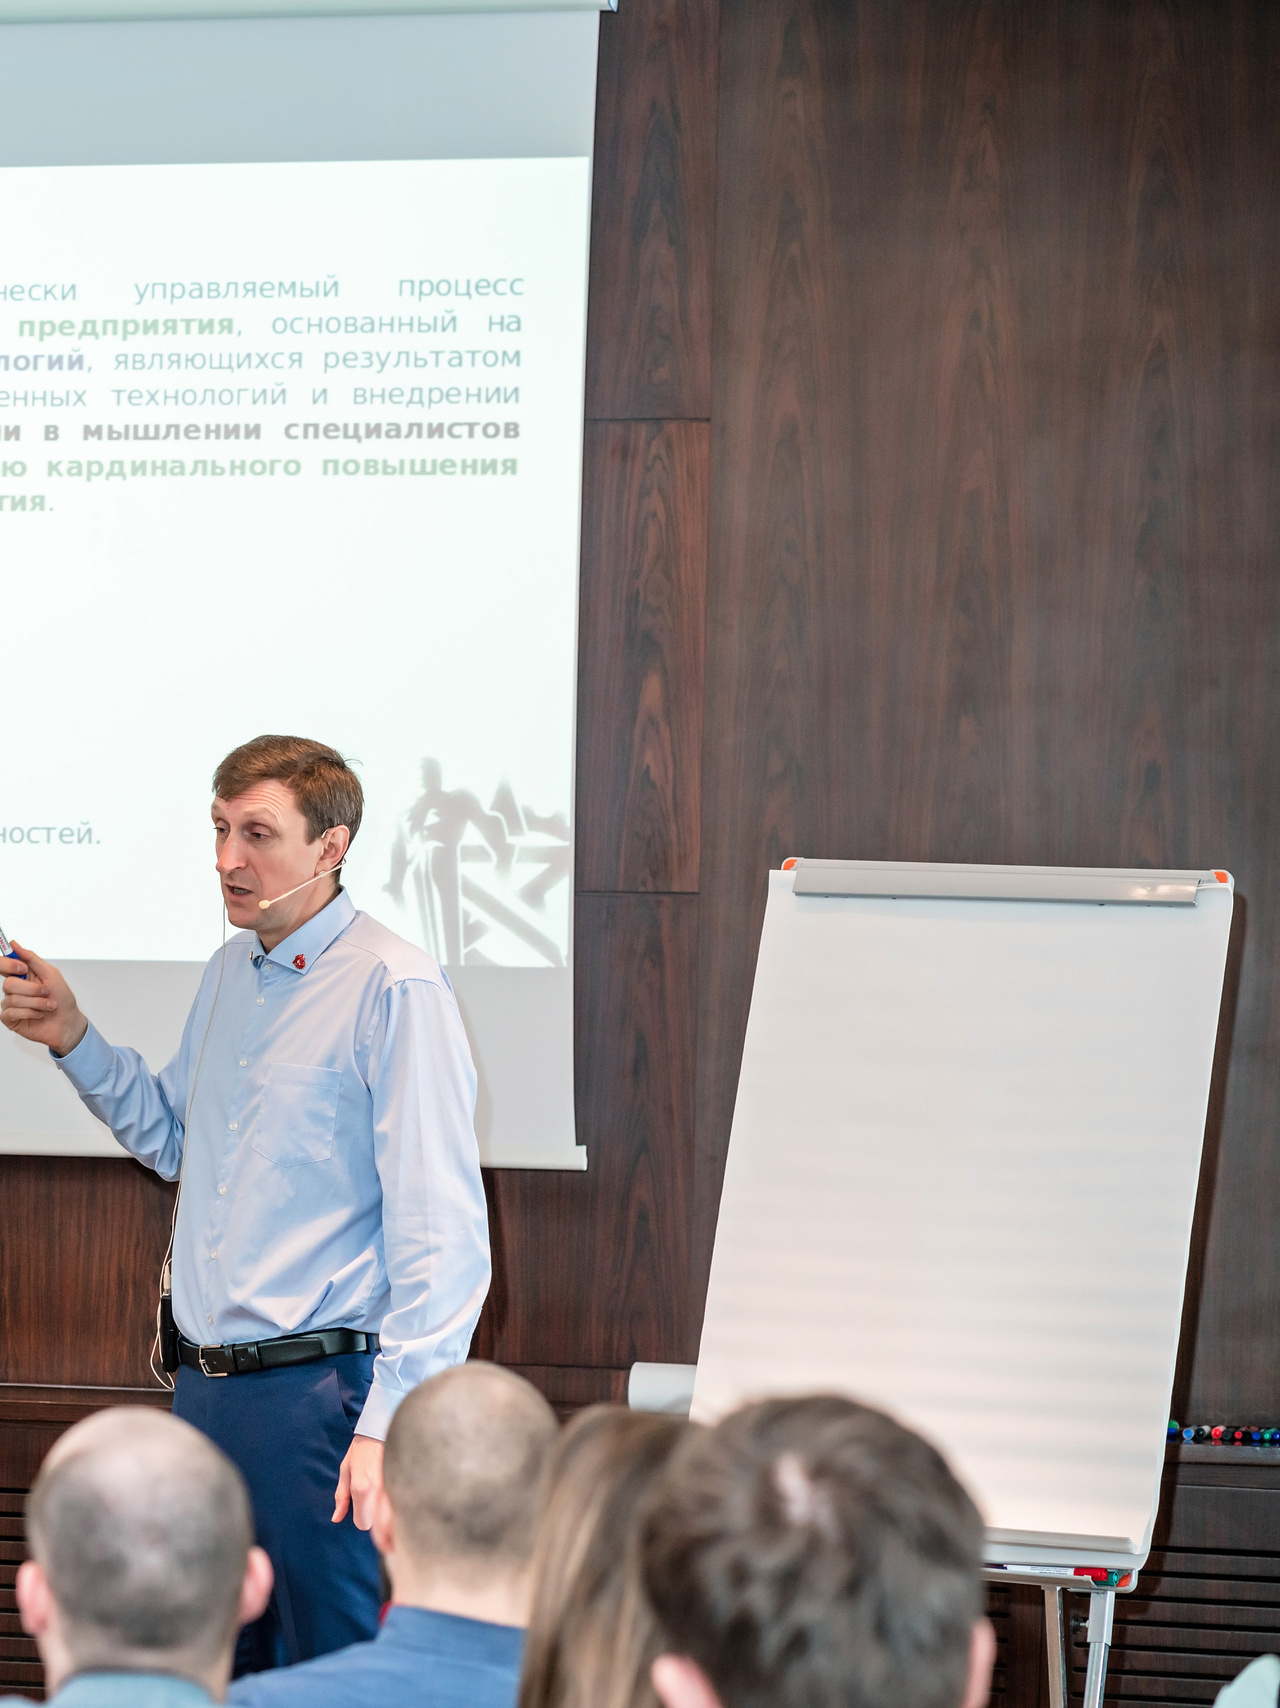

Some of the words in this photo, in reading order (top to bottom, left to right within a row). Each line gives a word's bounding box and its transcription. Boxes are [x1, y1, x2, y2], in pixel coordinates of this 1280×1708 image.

[133, 272, 340, 307] управляемый
[398, 276, 525, 304] процесс
[18, 316, 243, 344] предприятия,
[271, 307, 458, 336] основанный
[487, 312, 523, 334] на
[113, 350, 304, 375] являющихся
[323, 348, 522, 376] результатом
[110, 380, 287, 408] технологий
[311, 386, 329, 407] и
[352, 384, 521, 412] внедрении
[43, 422, 60, 443] в
[82, 421, 262, 443] мышлении
[283, 419, 521, 446] специалистов
[46, 457, 303, 484] кардинального
[321, 456, 519, 478] повышения
